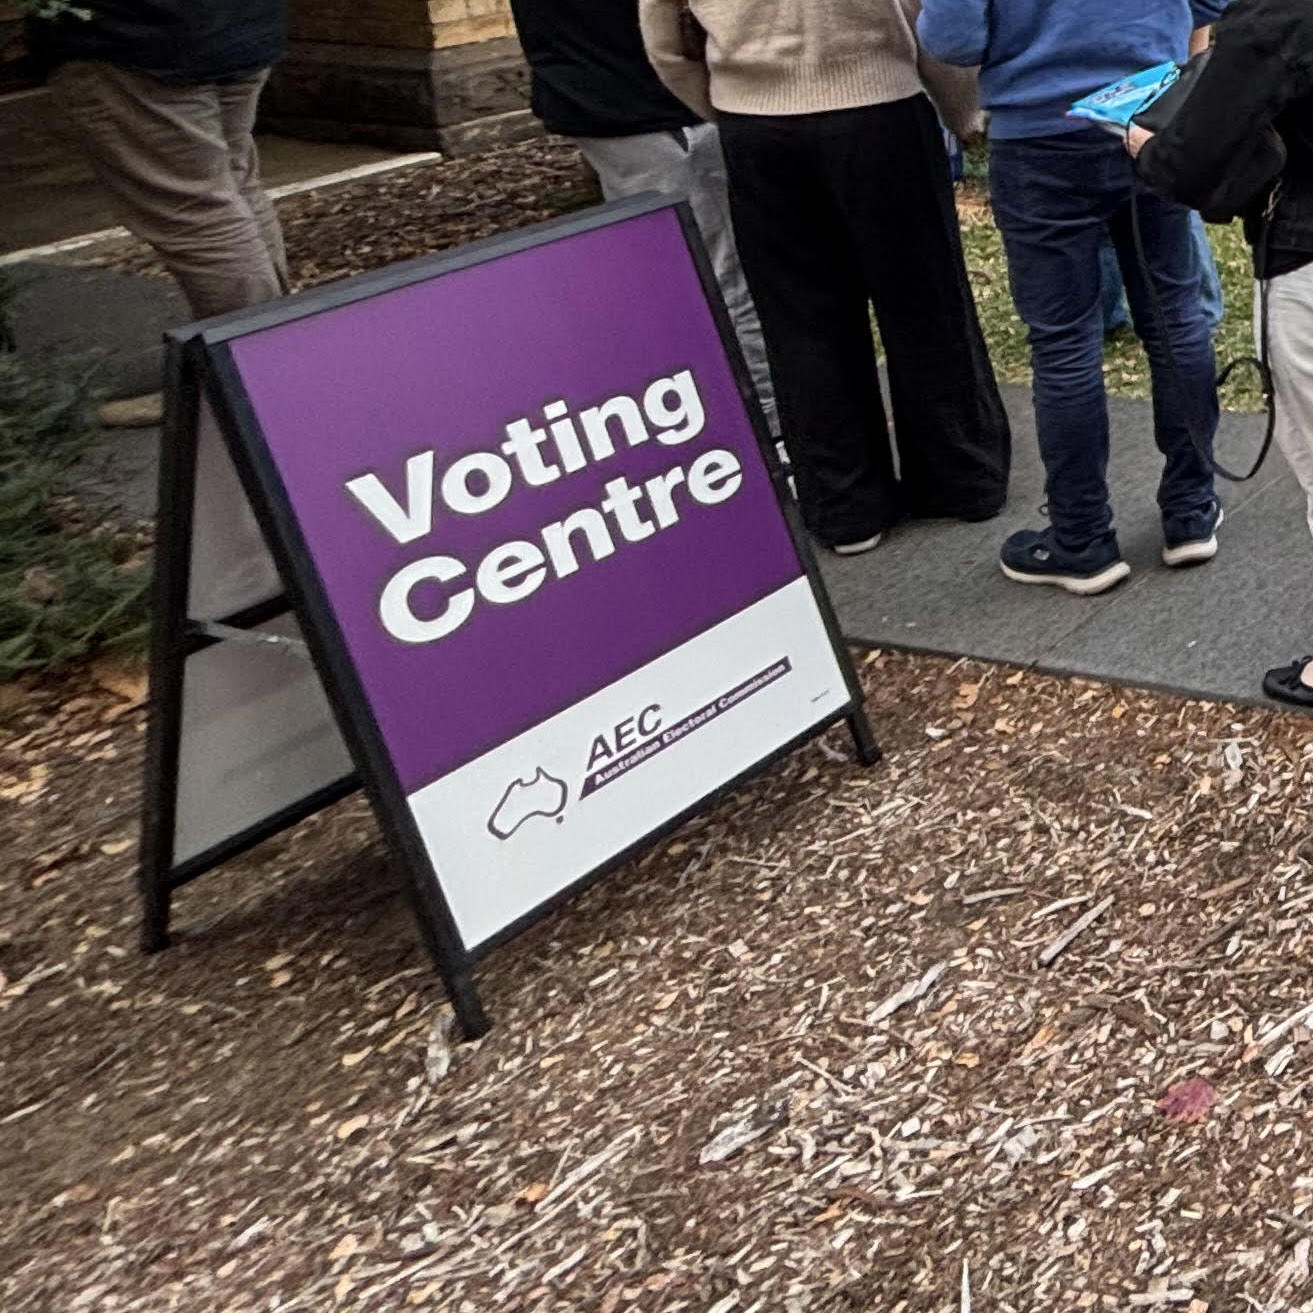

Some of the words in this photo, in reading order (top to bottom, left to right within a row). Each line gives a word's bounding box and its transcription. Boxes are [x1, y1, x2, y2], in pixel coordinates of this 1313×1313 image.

[344, 369, 706, 545] Voting
[379, 449, 744, 644] Centre
[586, 702, 664, 773] AEC
[594, 741, 660, 786] Australian
[663, 700, 716, 742] Electoral
[719, 663, 785, 708] Commission
